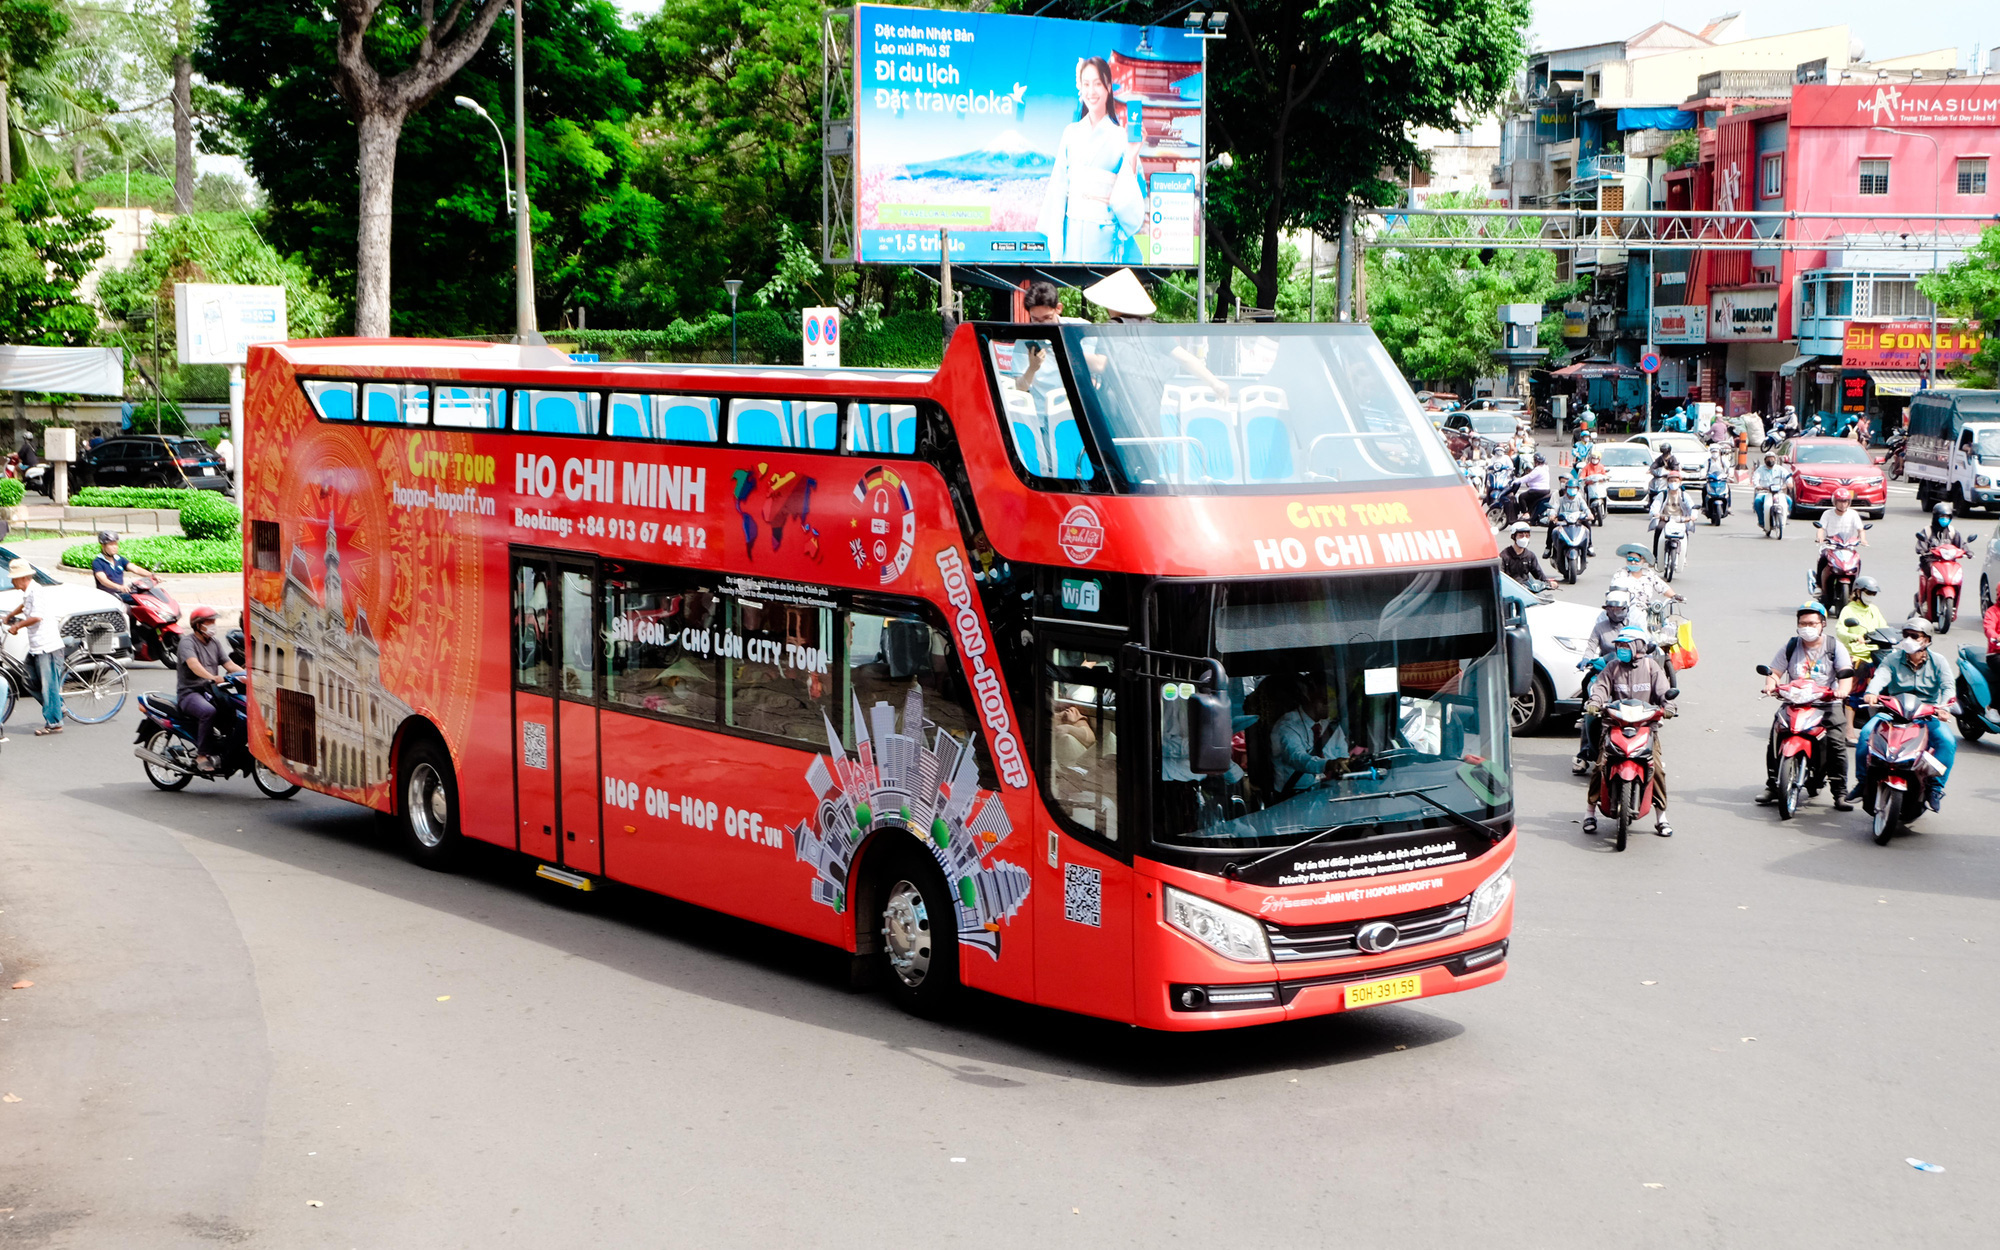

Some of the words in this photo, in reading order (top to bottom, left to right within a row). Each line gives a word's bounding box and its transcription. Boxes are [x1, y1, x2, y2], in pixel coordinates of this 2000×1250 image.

[874, 24, 896, 40] Đặt
[897, 25, 924, 40] chân
[926, 27, 952, 43] Nhật
[954, 28, 974, 42] Bản
[875, 41, 896, 54] Leo
[898, 42, 914, 56] núi
[916, 44, 937, 58] Phú
[874, 60, 896, 81] Đi
[899, 62, 923, 83] du
[926, 62, 960, 89] lịch
[874, 88, 910, 114] Đặt
[914, 88, 1013, 114] traveloka
[1541, 114, 1567, 124] NAM
[1900, 114, 1918, 122] Trung
[1958, 114, 1972, 122] Duy
[1154, 180, 1187, 192] traveloka
[895, 234, 917, 254] 1,5
[1880, 332, 1952, 349] SONG
[1846, 358, 1857, 366] 22
[515, 453, 556, 499] HO
[562, 457, 614, 504] CHI
[622, 462, 706, 513] MINH
[392, 482, 496, 518] hopon-hopoff.vn
[514, 508, 572, 538] Booking:
[577, 514, 605, 537] +84
[608, 518, 636, 541] 913
[640, 522, 660, 544] 67
[662, 524, 682, 546] 44
[688, 526, 706, 549] 12
[1254, 538, 1307, 570] HO
[1314, 534, 1374, 566] CHI
[1378, 529, 1463, 564] MINH
[807, 596, 838, 608] Government
[1062, 586, 1095, 606] WiFi
[611, 612, 634, 642] SÀI
[638, 616, 666, 646] GÒN
[682, 627, 710, 660] CHỢ
[714, 627, 743, 660] LỚN
[747, 638, 782, 666] CITY
[786, 644, 828, 674] TOUR
[937, 547, 1028, 788] HOPON-HOPOFF
[604, 776, 640, 811] HOP
[645, 786, 718, 832] ON-HOP
[1307, 860, 1318, 870] án
[1330, 856, 1350, 868] điểm
[1350, 854, 1368, 866] phát
[1368, 851, 1386, 862] triển
[1386, 850, 1396, 860] du
[1397, 848, 1410, 860] lịch
[1410, 846, 1422, 857] của
[1422, 844, 1442, 854] Chính
[1442, 841, 1456, 853] phủ
[1279, 874, 1309, 884] Priority
[1309, 871, 1338, 882] Project
[1338, 870, 1347, 878] to
[1347, 866, 1377, 877] develop
[1377, 862, 1405, 874] tourism
[1405, 860, 1414, 870] by
[1414, 858, 1426, 868] the
[1427, 852, 1467, 866] Government
[1346, 888, 1364, 902] VIỆT
[1365, 879, 1430, 899] HOPON-HOPOFF
[1430, 878, 1443, 888] VN
[1352, 980, 1415, 1002] 50H-391.59
